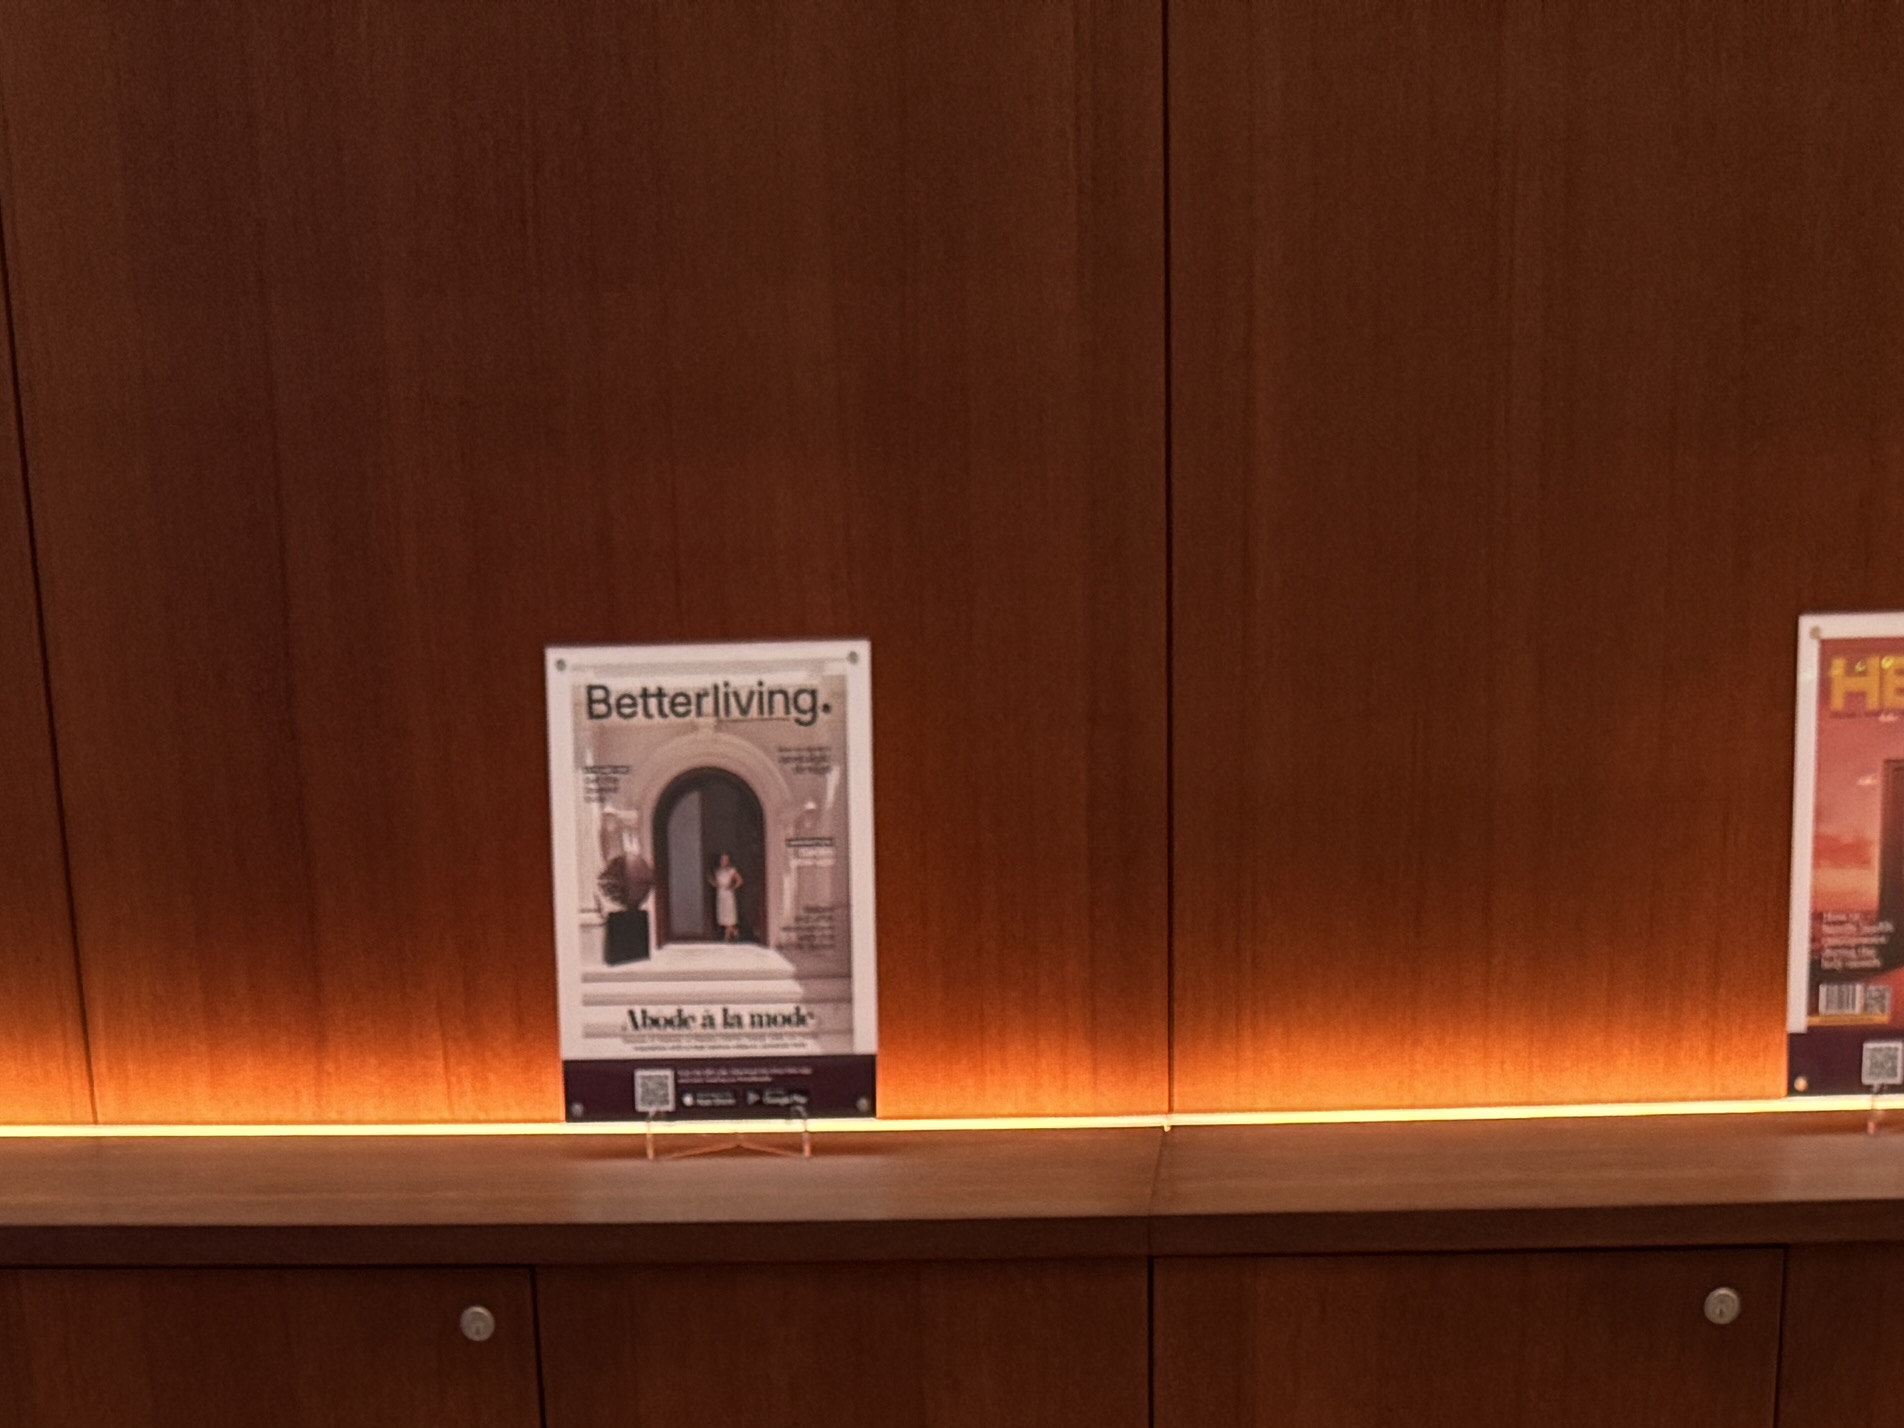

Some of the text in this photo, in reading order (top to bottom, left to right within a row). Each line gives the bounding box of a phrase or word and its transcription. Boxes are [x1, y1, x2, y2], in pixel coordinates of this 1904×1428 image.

[585, 681, 832, 727] Betterliving.
[621, 1007, 696, 1032] Abode
[722, 1006, 744, 1030] la
[749, 1005, 816, 1030] mode
